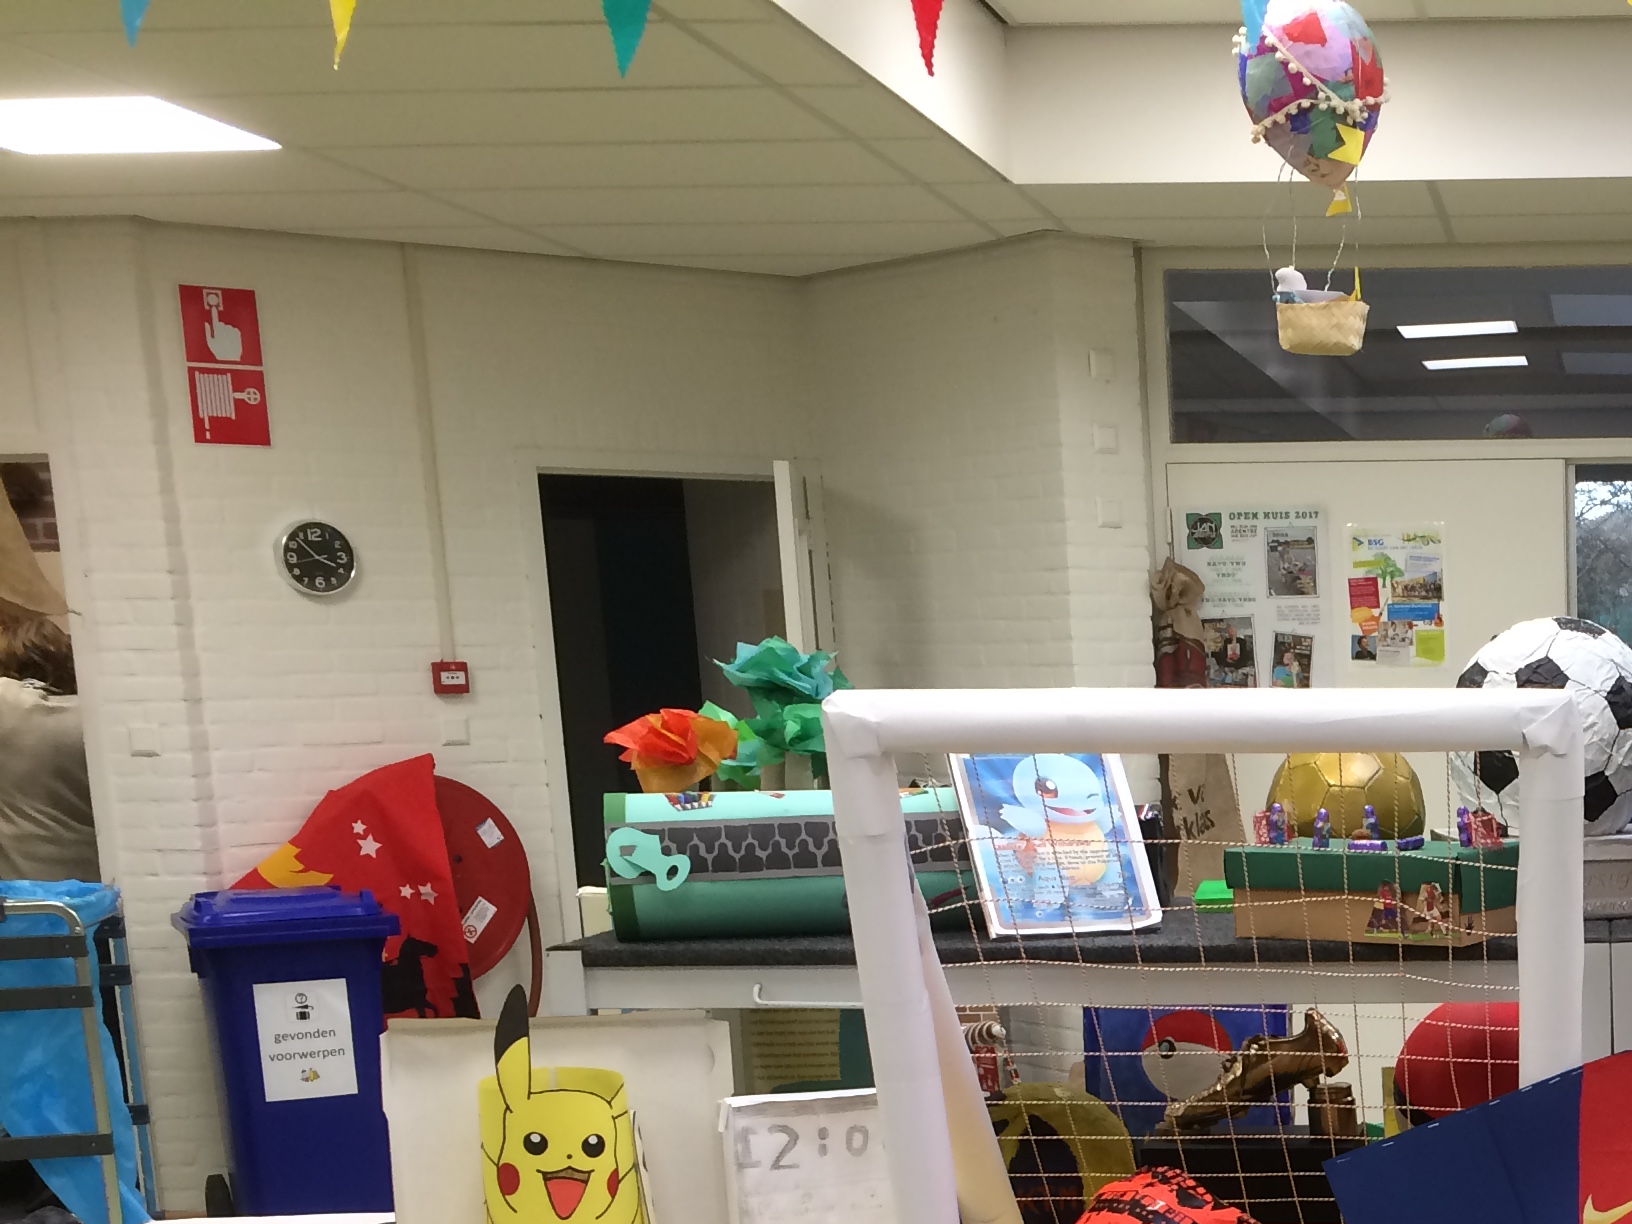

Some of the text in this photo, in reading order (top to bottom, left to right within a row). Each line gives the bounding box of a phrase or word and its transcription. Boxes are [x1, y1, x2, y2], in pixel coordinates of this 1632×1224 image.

[1228, 510, 1319, 521] OPEN HUIS 2017
[307, 528, 322, 541] 12
[287, 552, 297, 563] 9
[337, 552, 347, 563] 3
[315, 577, 326, 588] 6
[273, 1027, 337, 1044] gevonden
[268, 1046, 346, 1063] voorwerpen
